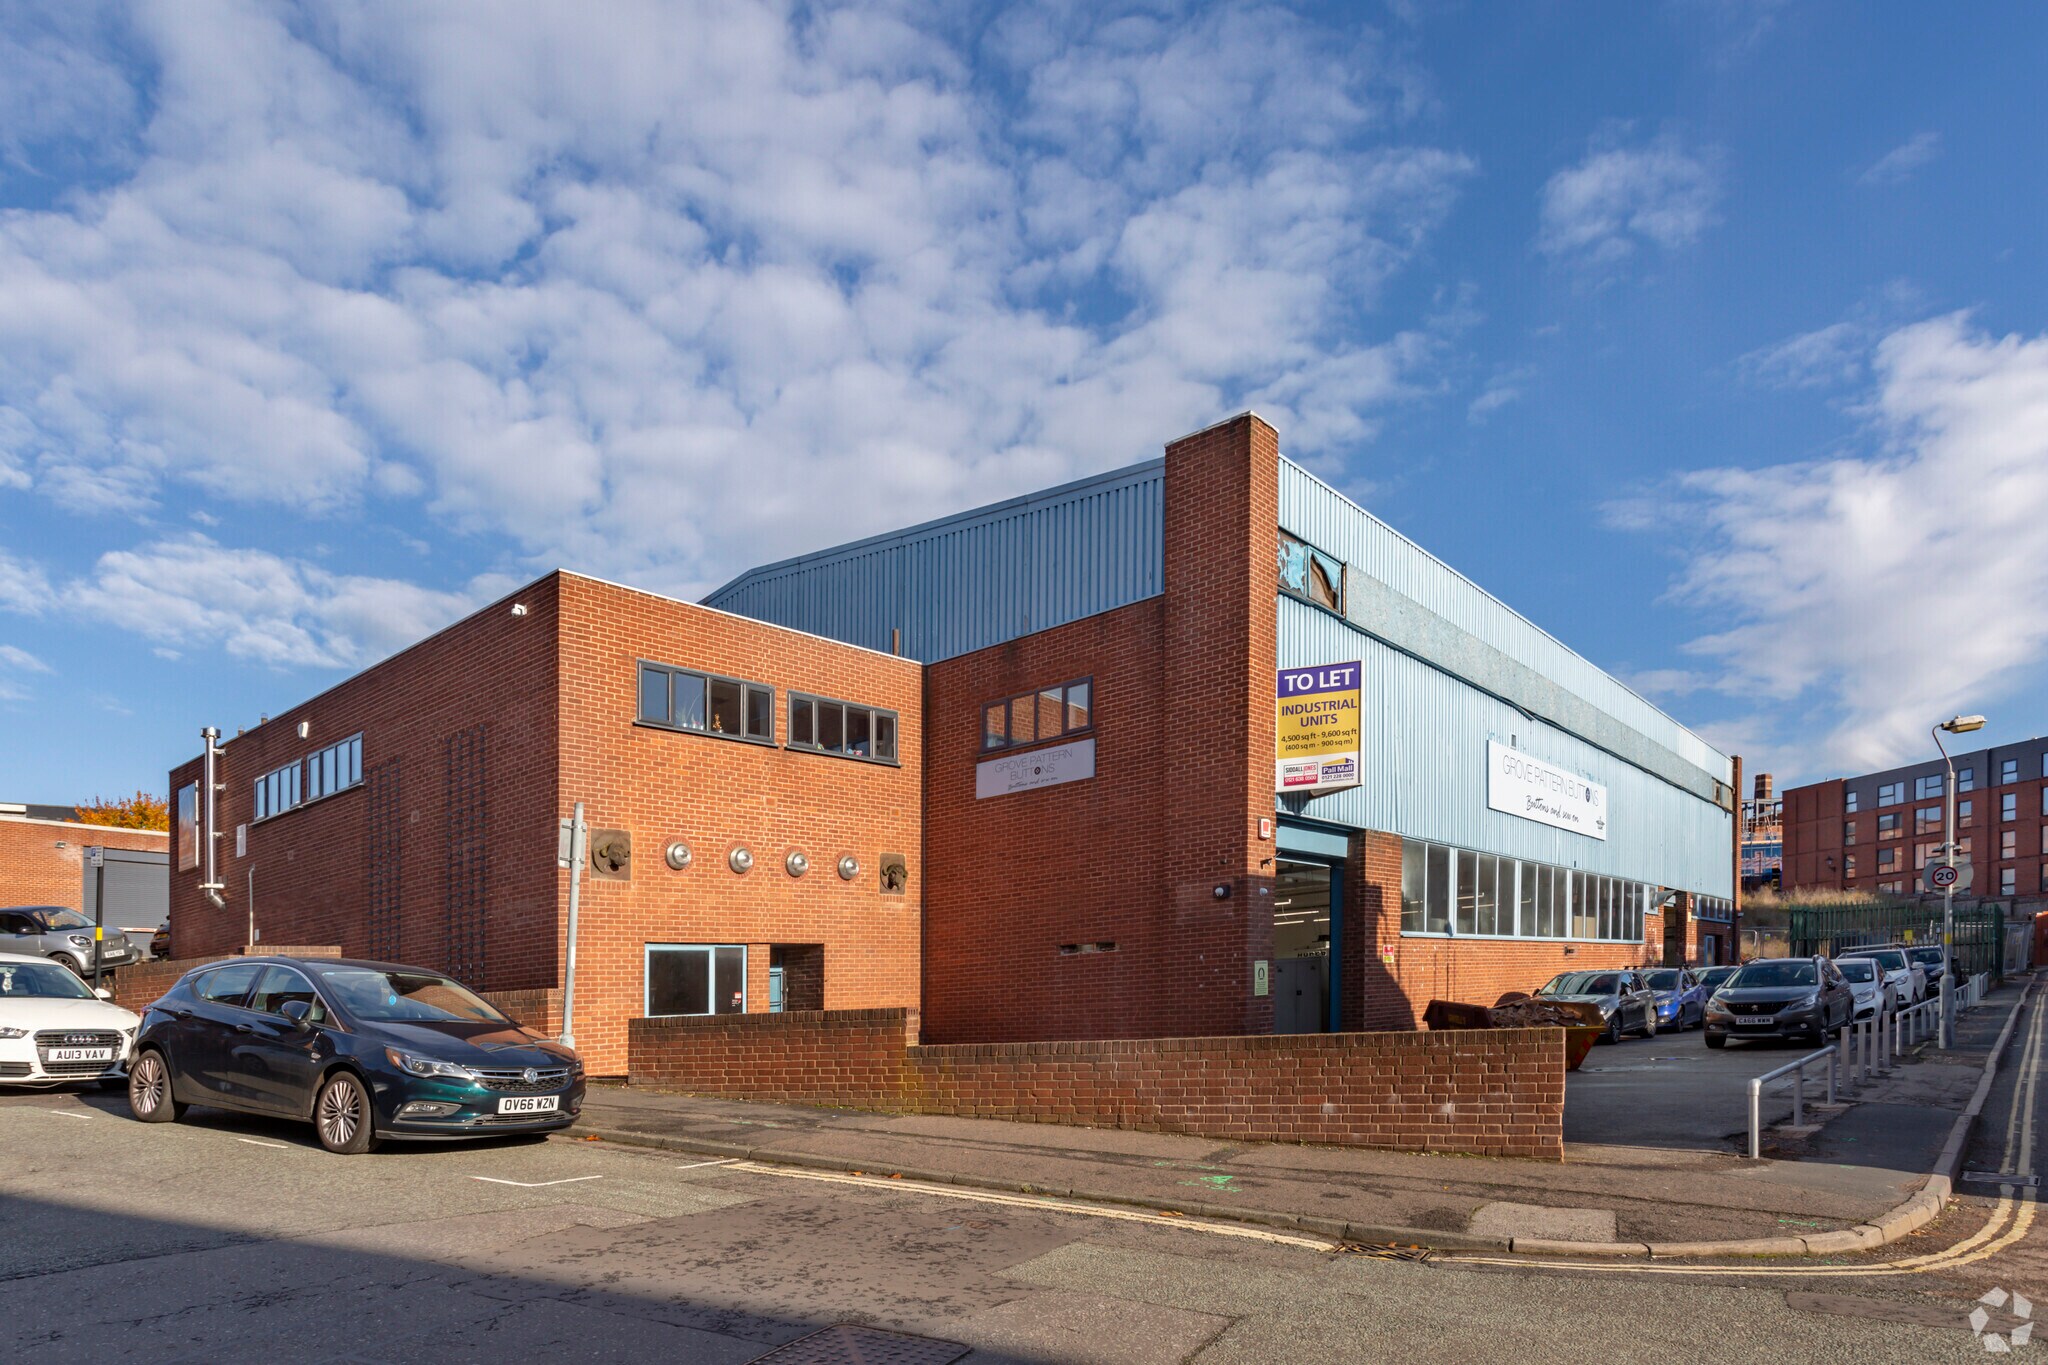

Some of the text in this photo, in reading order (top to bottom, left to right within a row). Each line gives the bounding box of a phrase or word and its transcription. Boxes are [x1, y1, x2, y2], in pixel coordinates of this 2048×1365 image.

[1284, 668, 1354, 692] TO LET
[1281, 698, 1357, 716] INDUSTRIAL
[1300, 713, 1338, 727] UNITS
[1281, 734, 1300, 743] 4,500
[1321, 729, 1340, 739] 9,600
[1285, 743, 1299, 751] (400
[994, 748, 1073, 774] GROVE PATTERN
[1010, 763, 1055, 780] BUTTONS
[1323, 766, 1336, 774] Pall
[1503, 754, 1599, 806] GROVE PATTERN BUTTONS
[1526, 795, 1549, 812] Buttons
[1550, 805, 1561, 818] and
[1936, 871, 1955, 881] 20
[56, 1049, 106, 1060] AU13 VAV
[504, 1097, 556, 1111] OV66 WZN
